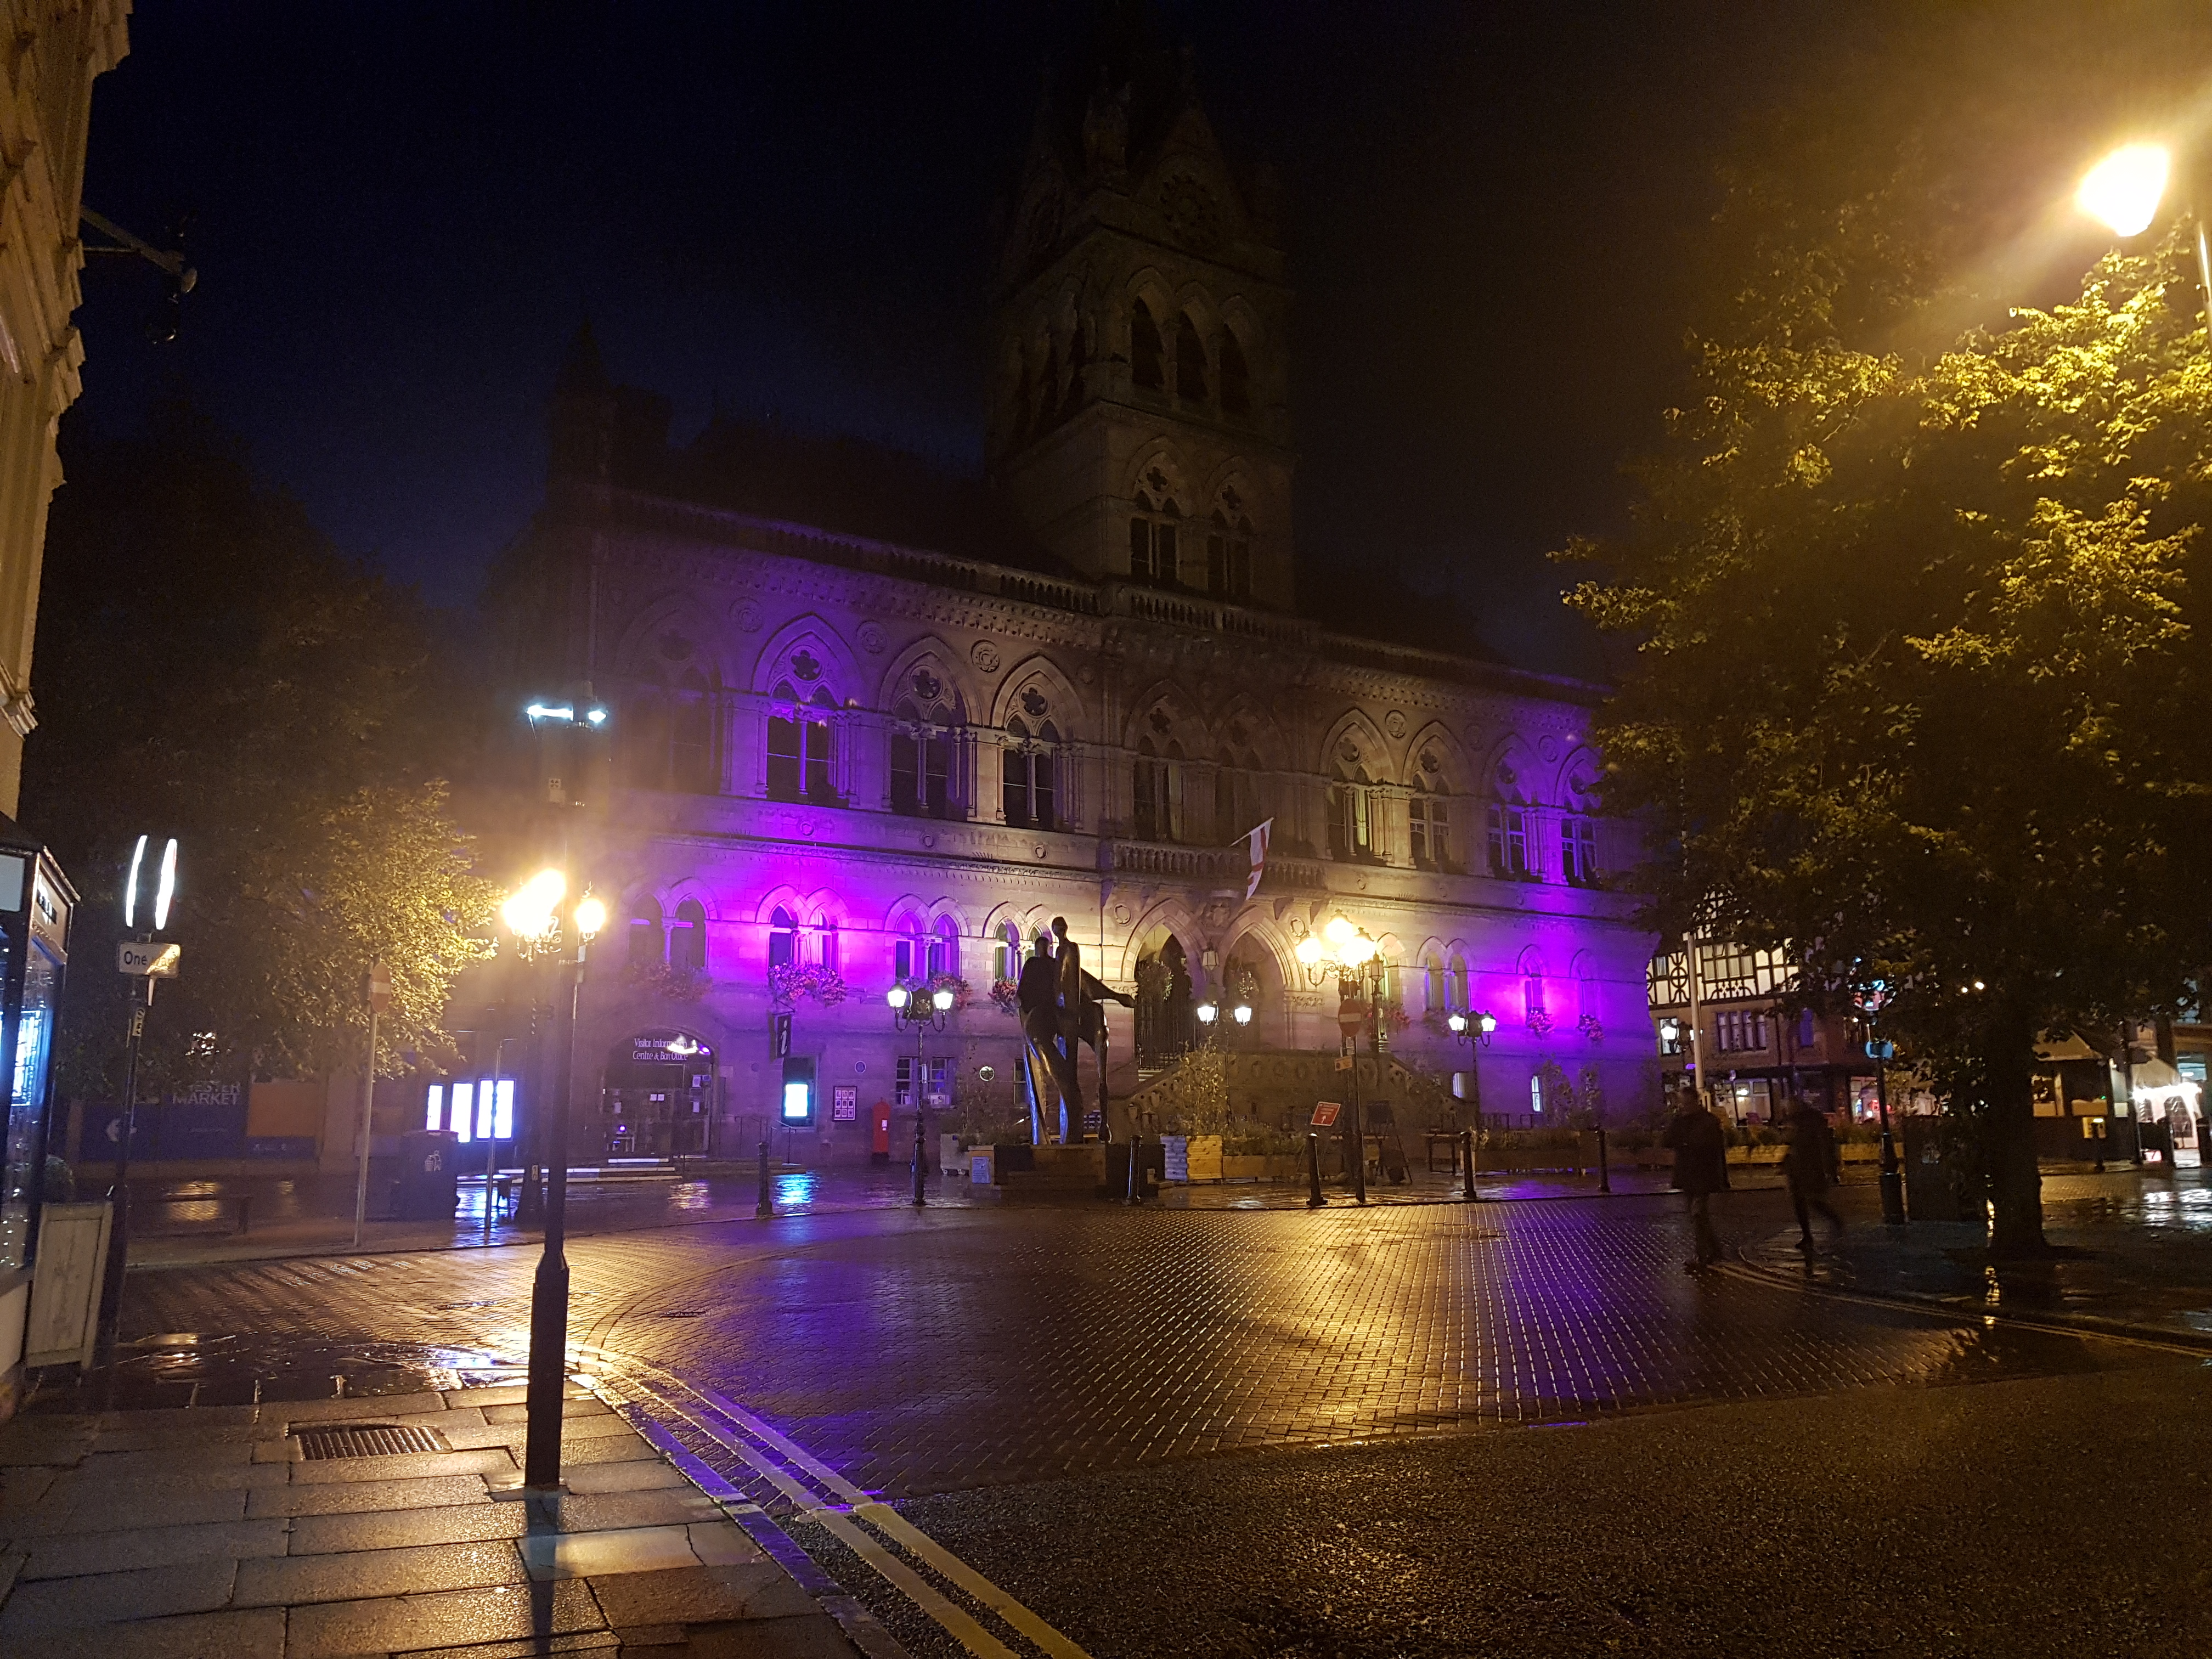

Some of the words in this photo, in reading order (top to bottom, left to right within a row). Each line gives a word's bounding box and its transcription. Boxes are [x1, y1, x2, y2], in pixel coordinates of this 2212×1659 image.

[125, 951, 148, 965] One
[634, 1038, 651, 1047] Visitor
[633, 1051, 653, 1060] Centre
[654, 1052, 659, 1061] &
[661, 1051, 670, 1060] Box
[172, 1092, 238, 1105] MARKET
